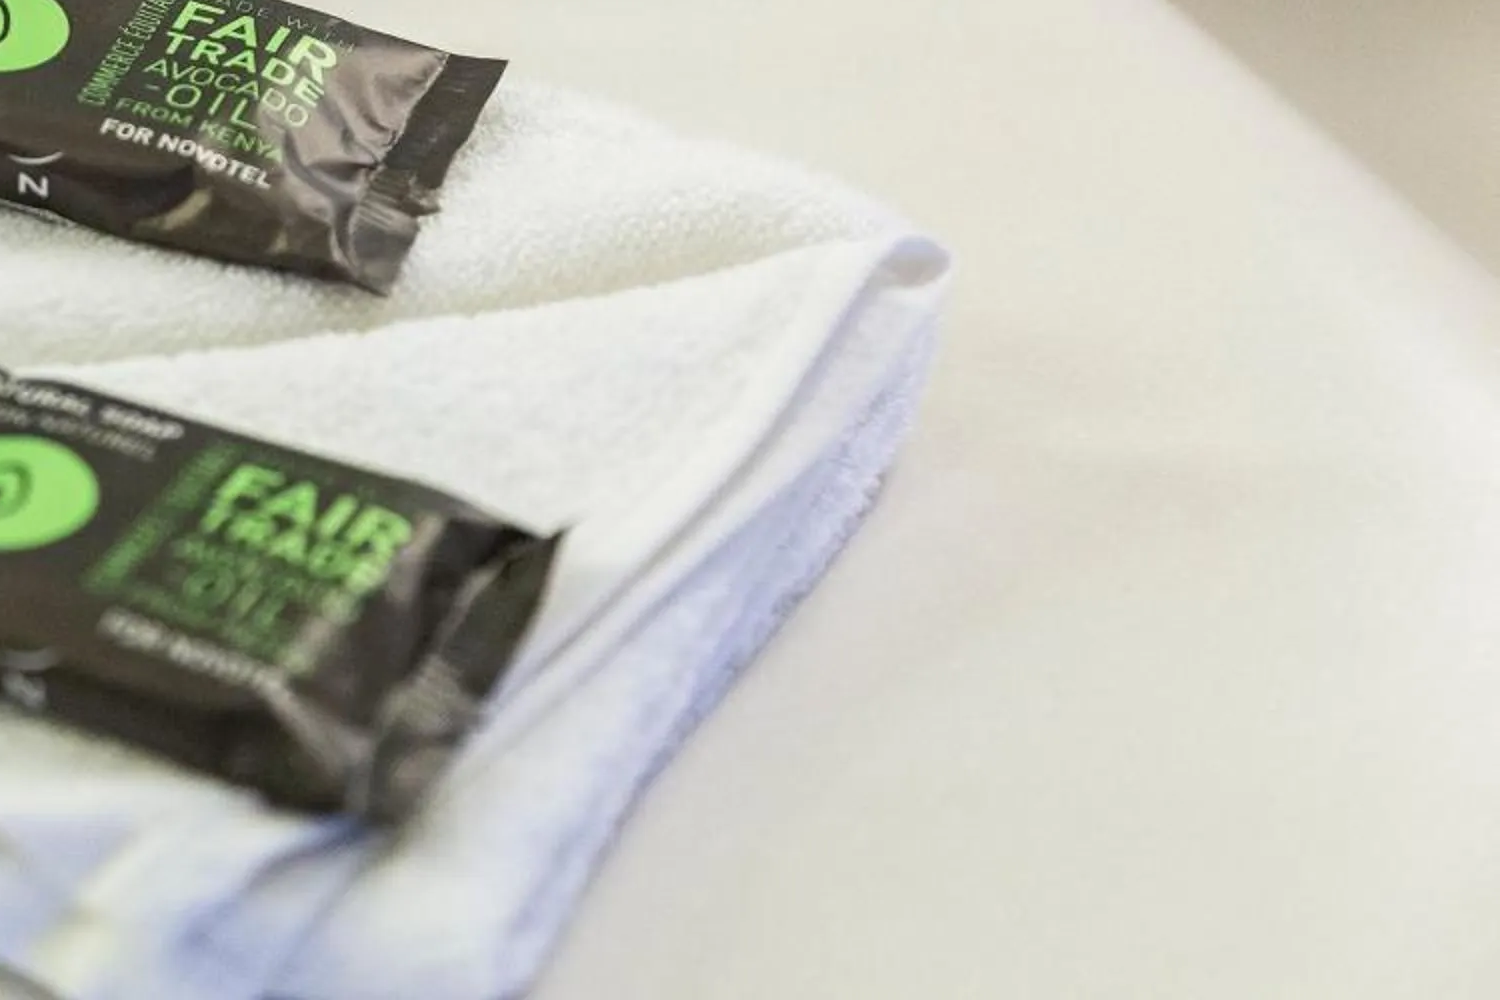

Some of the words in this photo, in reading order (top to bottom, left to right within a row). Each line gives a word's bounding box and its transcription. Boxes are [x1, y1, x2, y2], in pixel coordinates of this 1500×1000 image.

[78, 36, 144, 106] COMMERCE
[166, 31, 325, 108] TRADE
[170, 0, 337, 84] FAIR
[143, 59, 309, 128] AVOCADO
[100, 117, 154, 145] FOR
[157, 133, 271, 189] NOVOTEL
[115, 98, 193, 128] FROM
[199, 119, 283, 163] KENYA
[202, 463, 413, 560] FAIR
